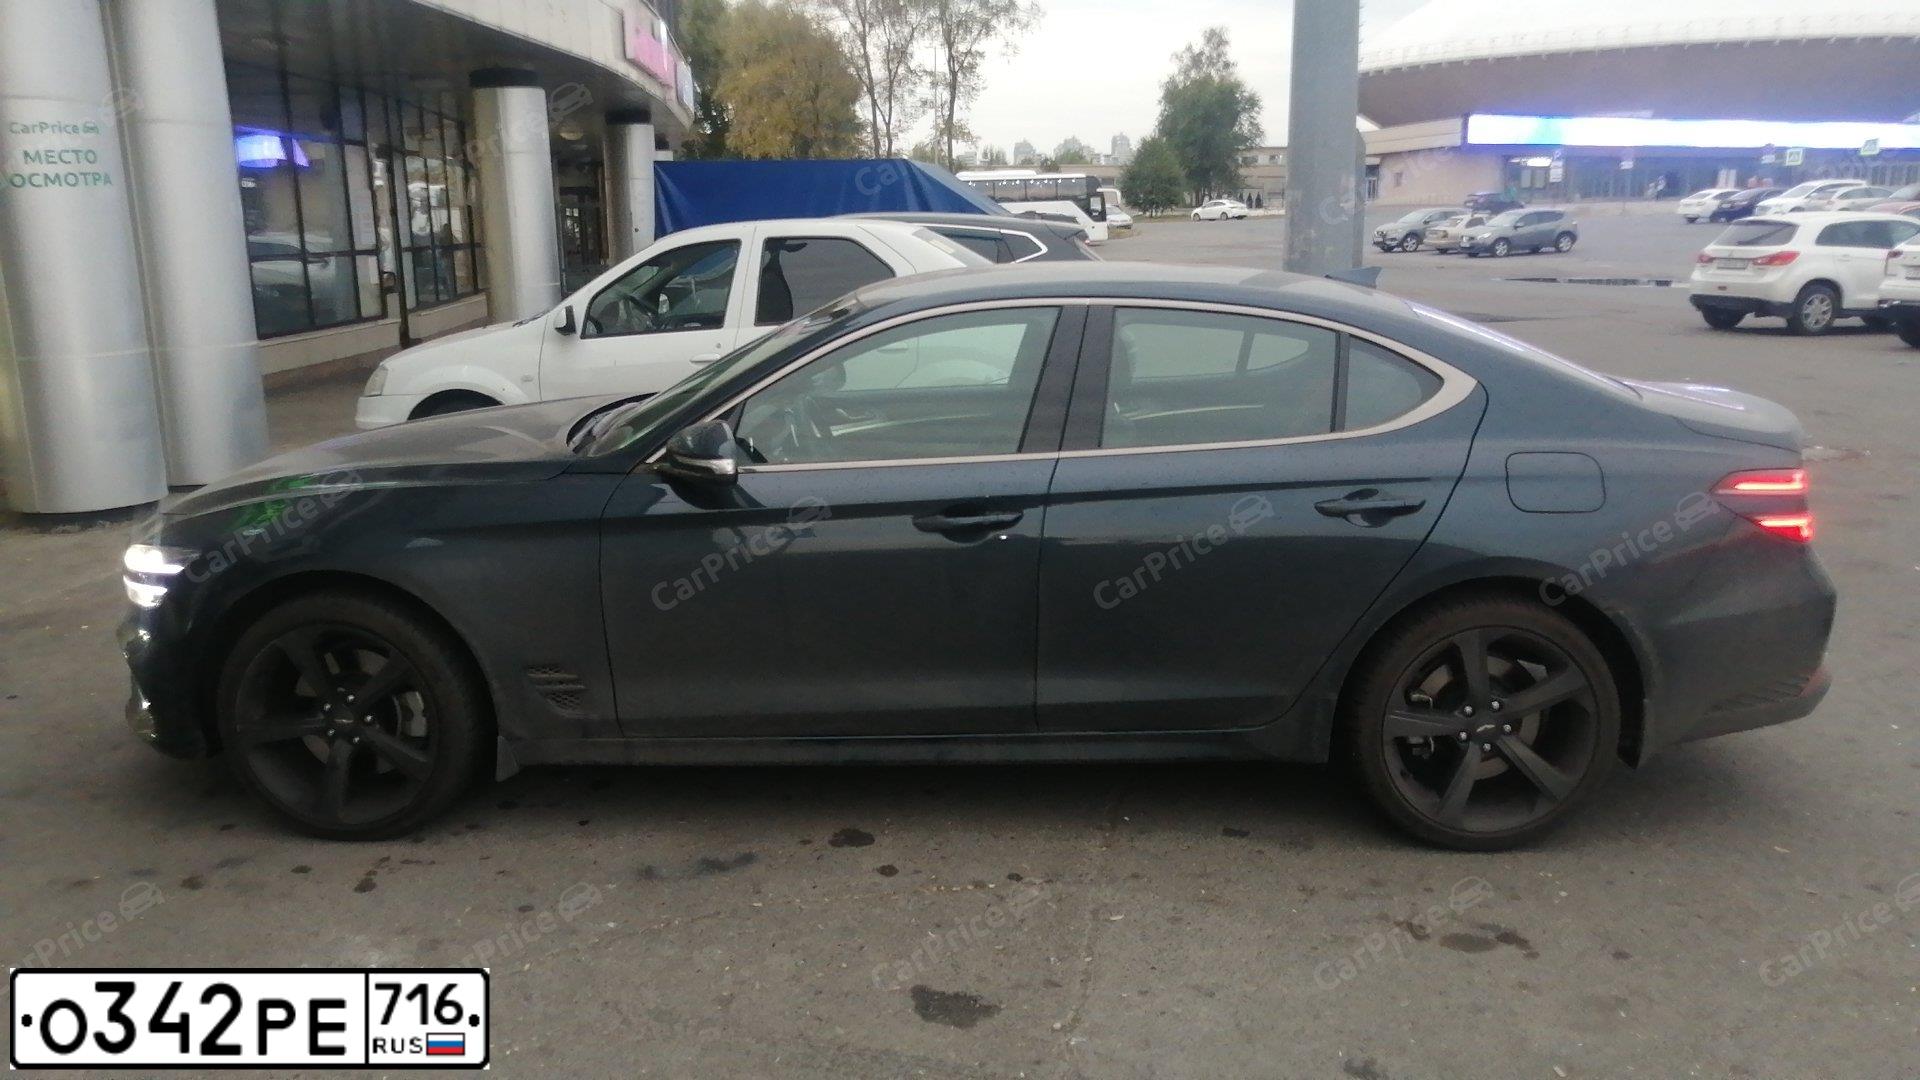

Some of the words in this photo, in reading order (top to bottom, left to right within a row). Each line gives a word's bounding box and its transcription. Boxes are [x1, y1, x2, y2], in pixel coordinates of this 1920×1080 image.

[9, 121, 81, 136] CarPrice
[23, 149, 98, 165] МЕСТО
[9, 172, 113, 188] ОСМОТРА
